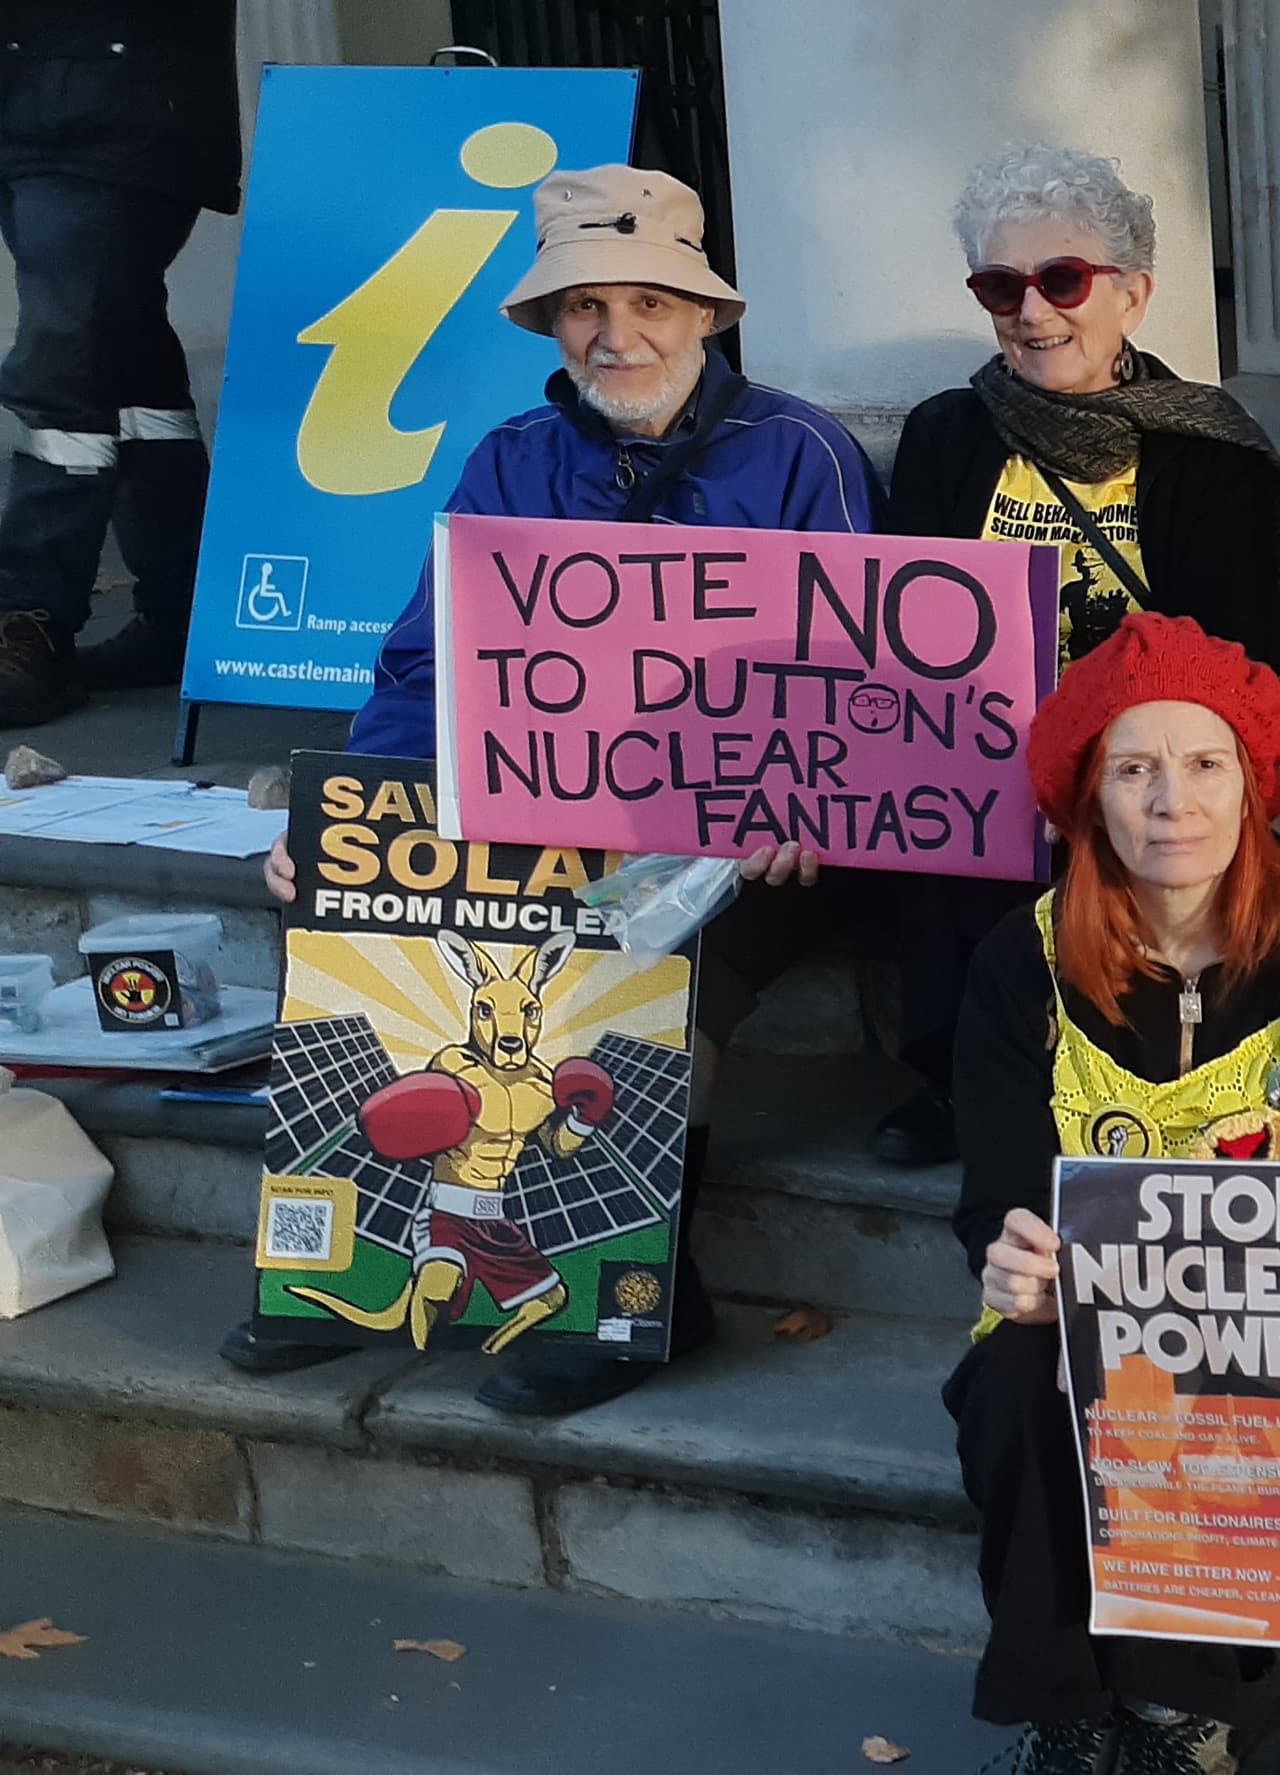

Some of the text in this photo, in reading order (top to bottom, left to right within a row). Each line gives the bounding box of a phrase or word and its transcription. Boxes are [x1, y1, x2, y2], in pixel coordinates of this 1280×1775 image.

[993, 492, 1032, 521] WELL
[990, 516, 1048, 541] SELDOM
[307, 614, 346, 636] Ramp
[491, 551, 997, 680] VOTE NO
[215, 659, 375, 684] www.castlemain
[476, 648, 586, 714] TO
[483, 728, 848, 801] NUCLEAR
[695, 784, 1000, 858] FANTASY
[314, 888, 629, 938] FROM NUCLEA
[1084, 1407, 1158, 1422] NUCLEAR
[1175, 1412, 1228, 1426] FOSSIL
[1232, 1414, 1273, 1429] FUEL
[1127, 1459, 1177, 1475] SLOW,
[1098, 1507, 1140, 1521] BUILT
[1145, 1510, 1176, 1523] FOR
[1233, 1536, 1280, 1548] CLIMATE
[1103, 1560, 1126, 1573] WE
[1130, 1561, 1169, 1576] HAVE
[1174, 1564, 1232, 1580] BETTER
[1236, 1568, 1272, 1583] NOW
[1104, 1580, 1160, 1594] BATTERIES
[1164, 1584, 1185, 1595] ARE
[1189, 1585, 1243, 1600] CHEAPER,
